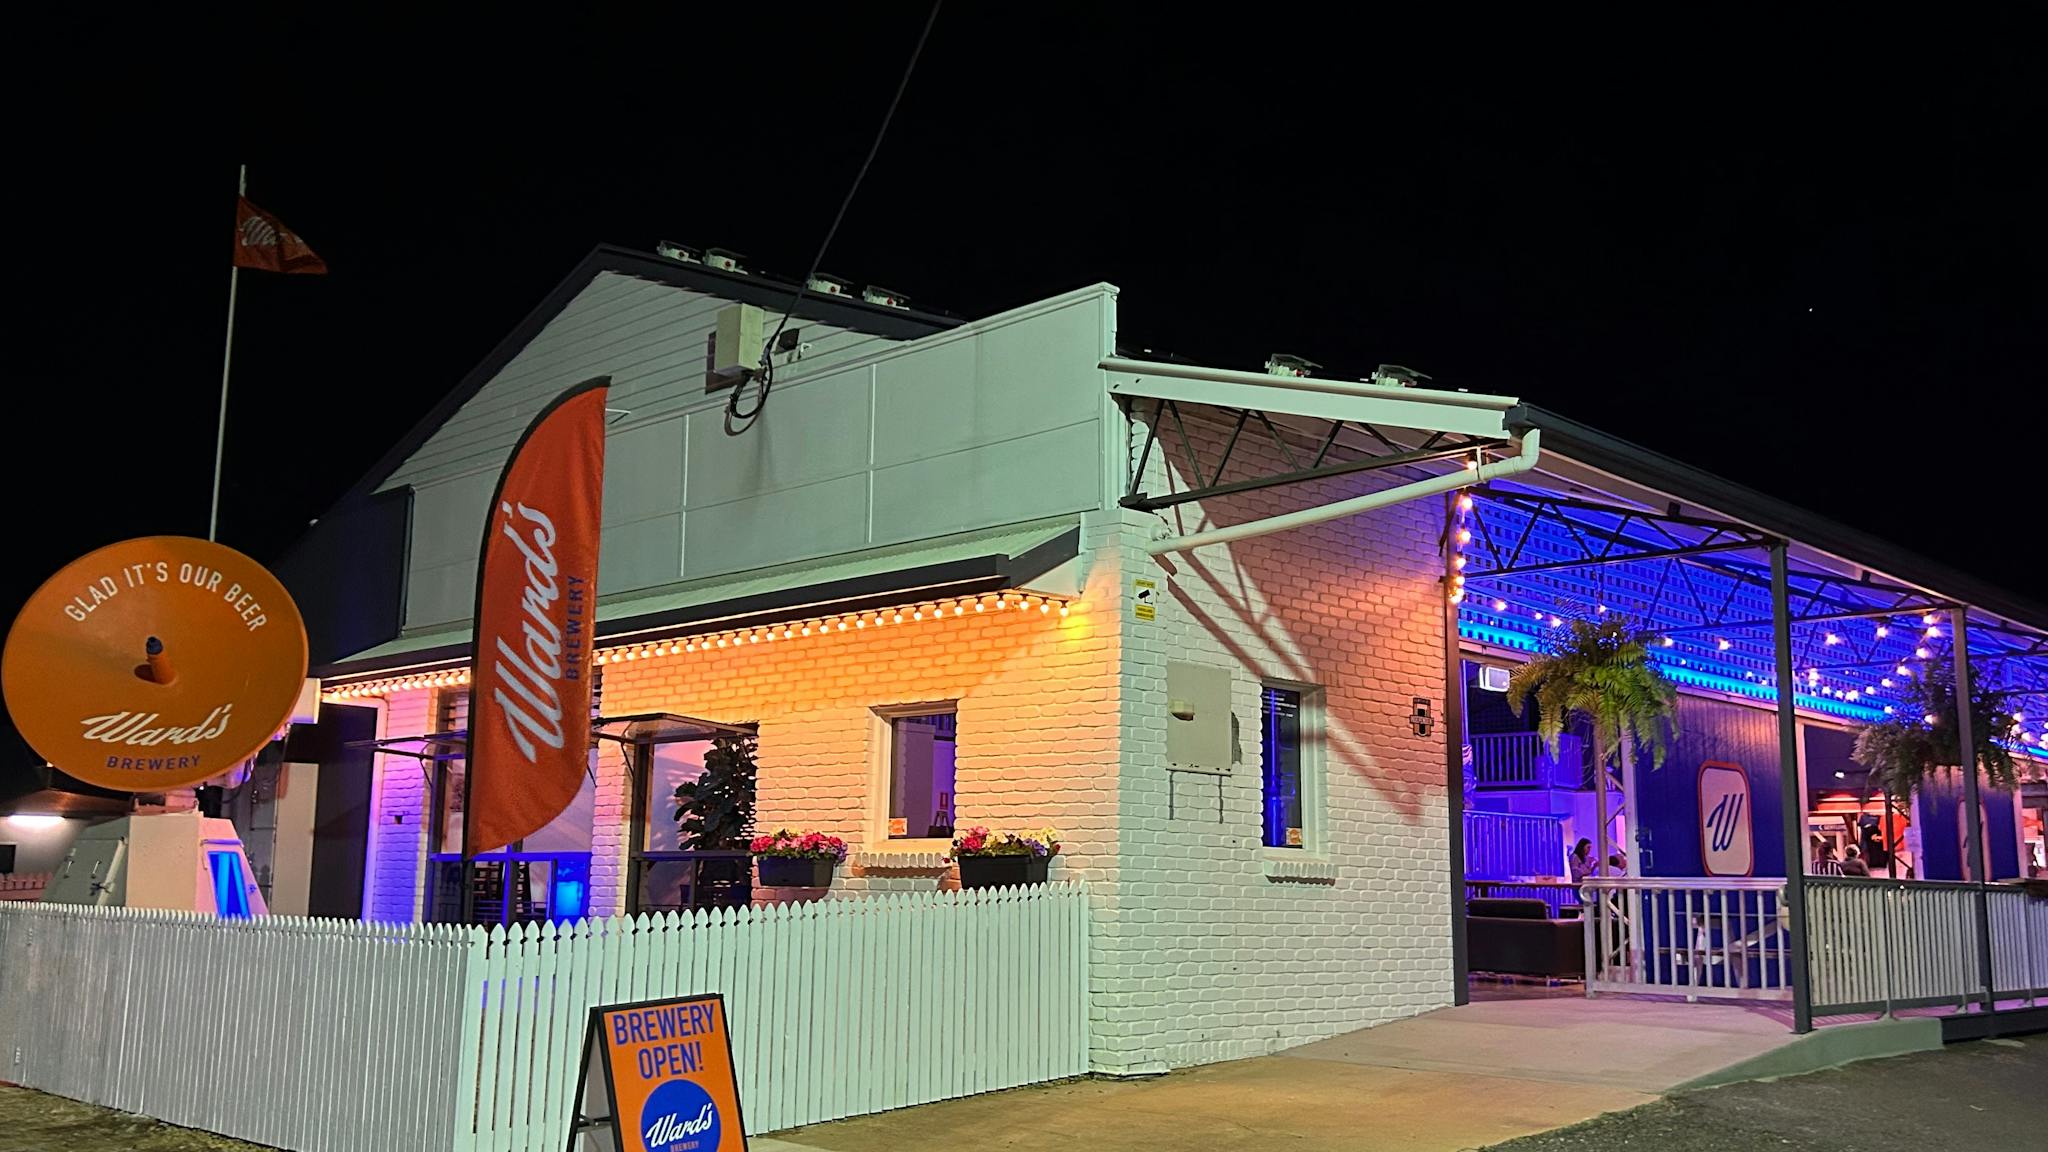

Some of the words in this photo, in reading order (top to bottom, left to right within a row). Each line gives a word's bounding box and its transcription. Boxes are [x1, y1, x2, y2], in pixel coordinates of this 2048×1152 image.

[63, 575, 118, 623] GLAD
[124, 562, 168, 588] IT'S
[179, 563, 223, 593] OUR
[223, 583, 268, 632] BEER
[494, 500, 564, 764] Ward's
[565, 575, 585, 681] BREWERY
[80, 703, 233, 747] Ward's
[106, 755, 201, 771] BREWERY
[613, 1003, 714, 1046] BREWERY
[638, 1041, 704, 1080] OPEN!
[645, 1102, 713, 1148] Ward's
